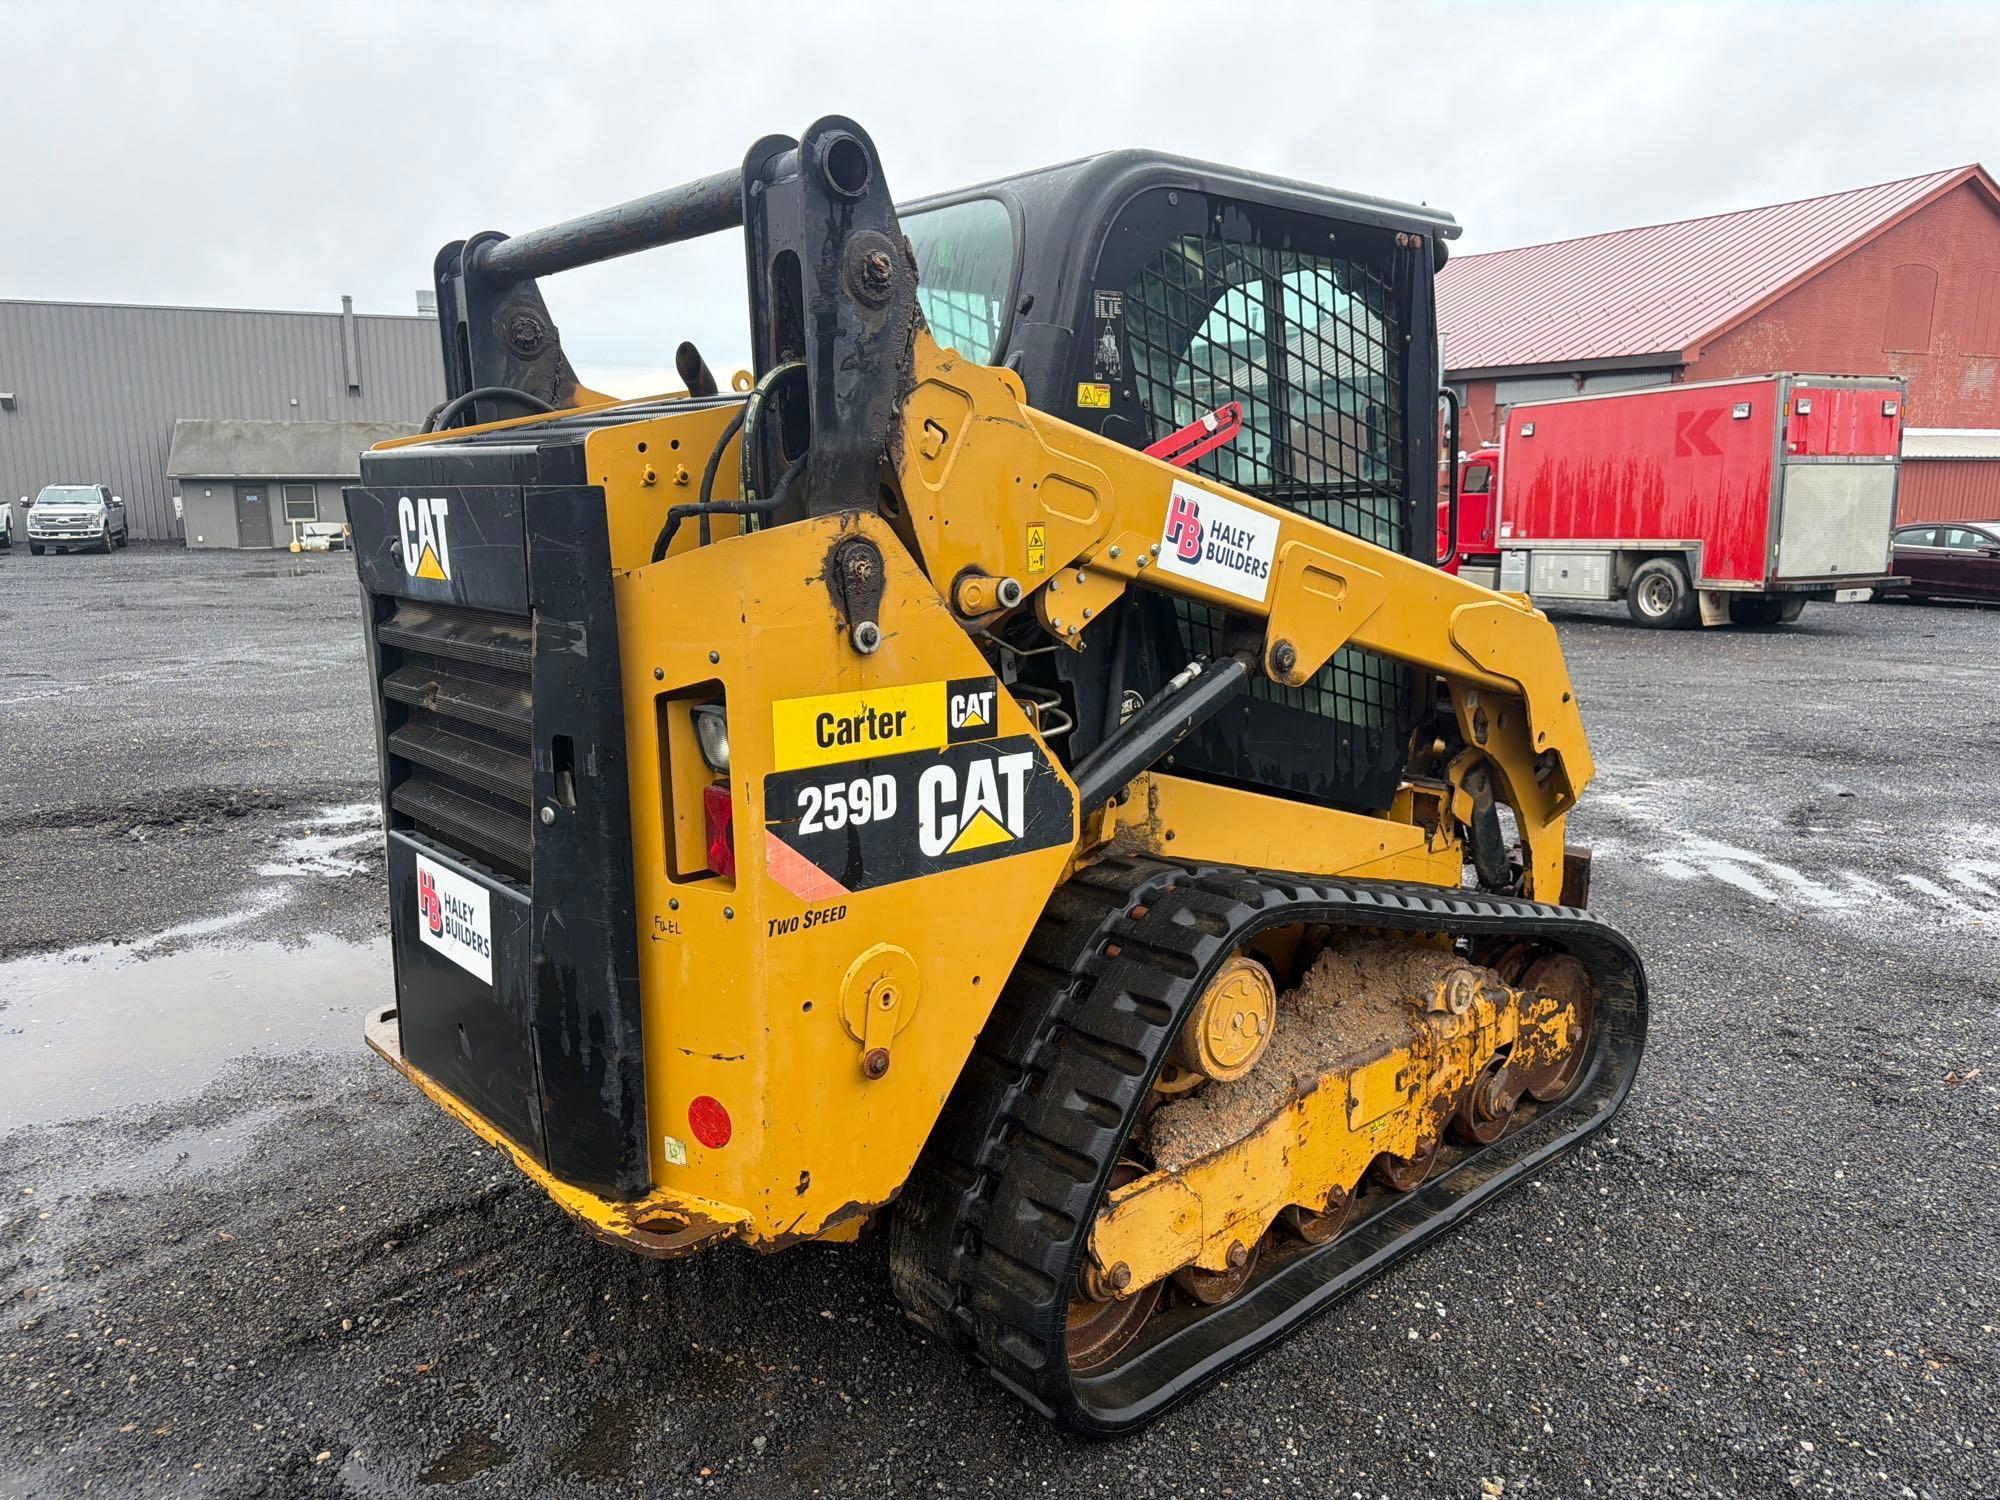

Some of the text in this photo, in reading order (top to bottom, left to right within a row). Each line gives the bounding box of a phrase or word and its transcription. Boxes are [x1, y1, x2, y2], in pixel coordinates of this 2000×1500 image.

[398, 496, 452, 581] CAT
[1210, 519, 1256, 552] HALEY
[1205, 541, 1269, 580] BUILDERS
[815, 707, 907, 748] Carter
[951, 691, 993, 729] CAT
[797, 773, 898, 836] 259D
[917, 751, 1034, 858] CAT
[444, 891, 475, 926] HALEY
[768, 905, 847, 937] TWO SPEED
[445, 914, 490, 959] BUILDERS
